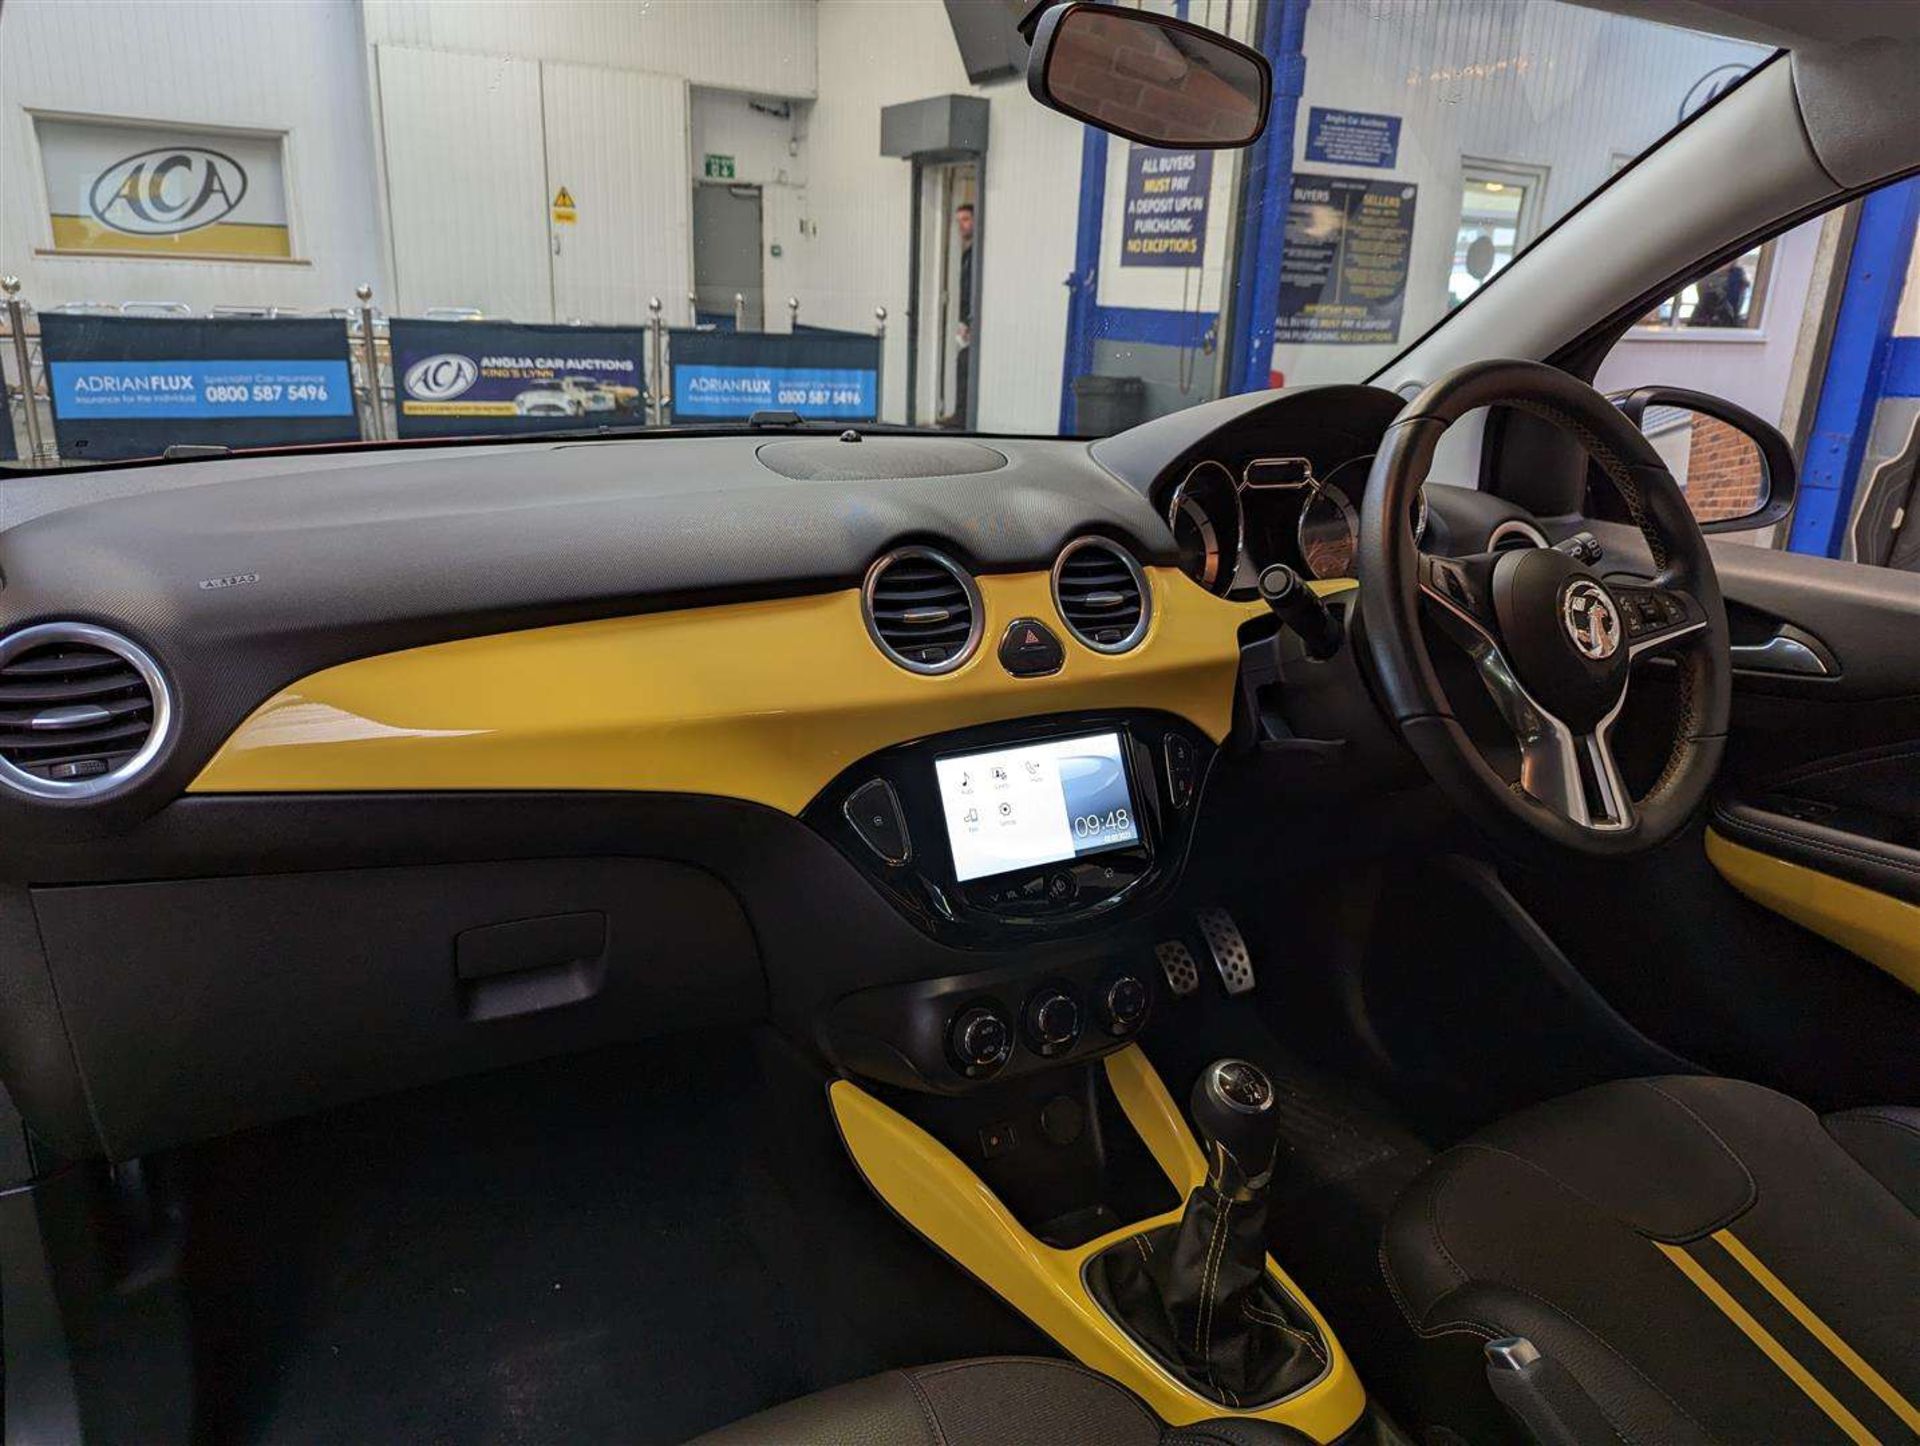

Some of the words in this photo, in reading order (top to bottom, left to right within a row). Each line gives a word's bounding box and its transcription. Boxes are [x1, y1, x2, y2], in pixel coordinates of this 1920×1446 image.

[1142, 157, 1158, 173] ALL
[1159, 155, 1195, 172] BUYERS
[101, 155, 233, 223] ACA
[1143, 177, 1170, 193] MUST
[1171, 176, 1190, 191] PAY
[1294, 188, 1330, 201] BUYERS
[1128, 199, 1135, 214] A
[1136, 198, 1174, 213] DEPOSIT
[1175, 196, 1204, 211] UPON
[1134, 218, 1193, 233] PURCHASING
[1127, 239, 1141, 252] NO
[1142, 239, 1197, 253] EXCEPTIONS
[480, 356, 534, 369] ANGLIA
[535, 357, 564, 369] CAR
[566, 358, 634, 371] AUCTIONS
[412, 361, 469, 393] ACA
[205, 386, 249, 402] 0800
[253, 385, 282, 402] 587
[287, 385, 328, 401] 5496
[778, 390, 807, 405] 0800
[808, 391, 831, 405] 587
[1075, 809, 1130, 838] 09:48
